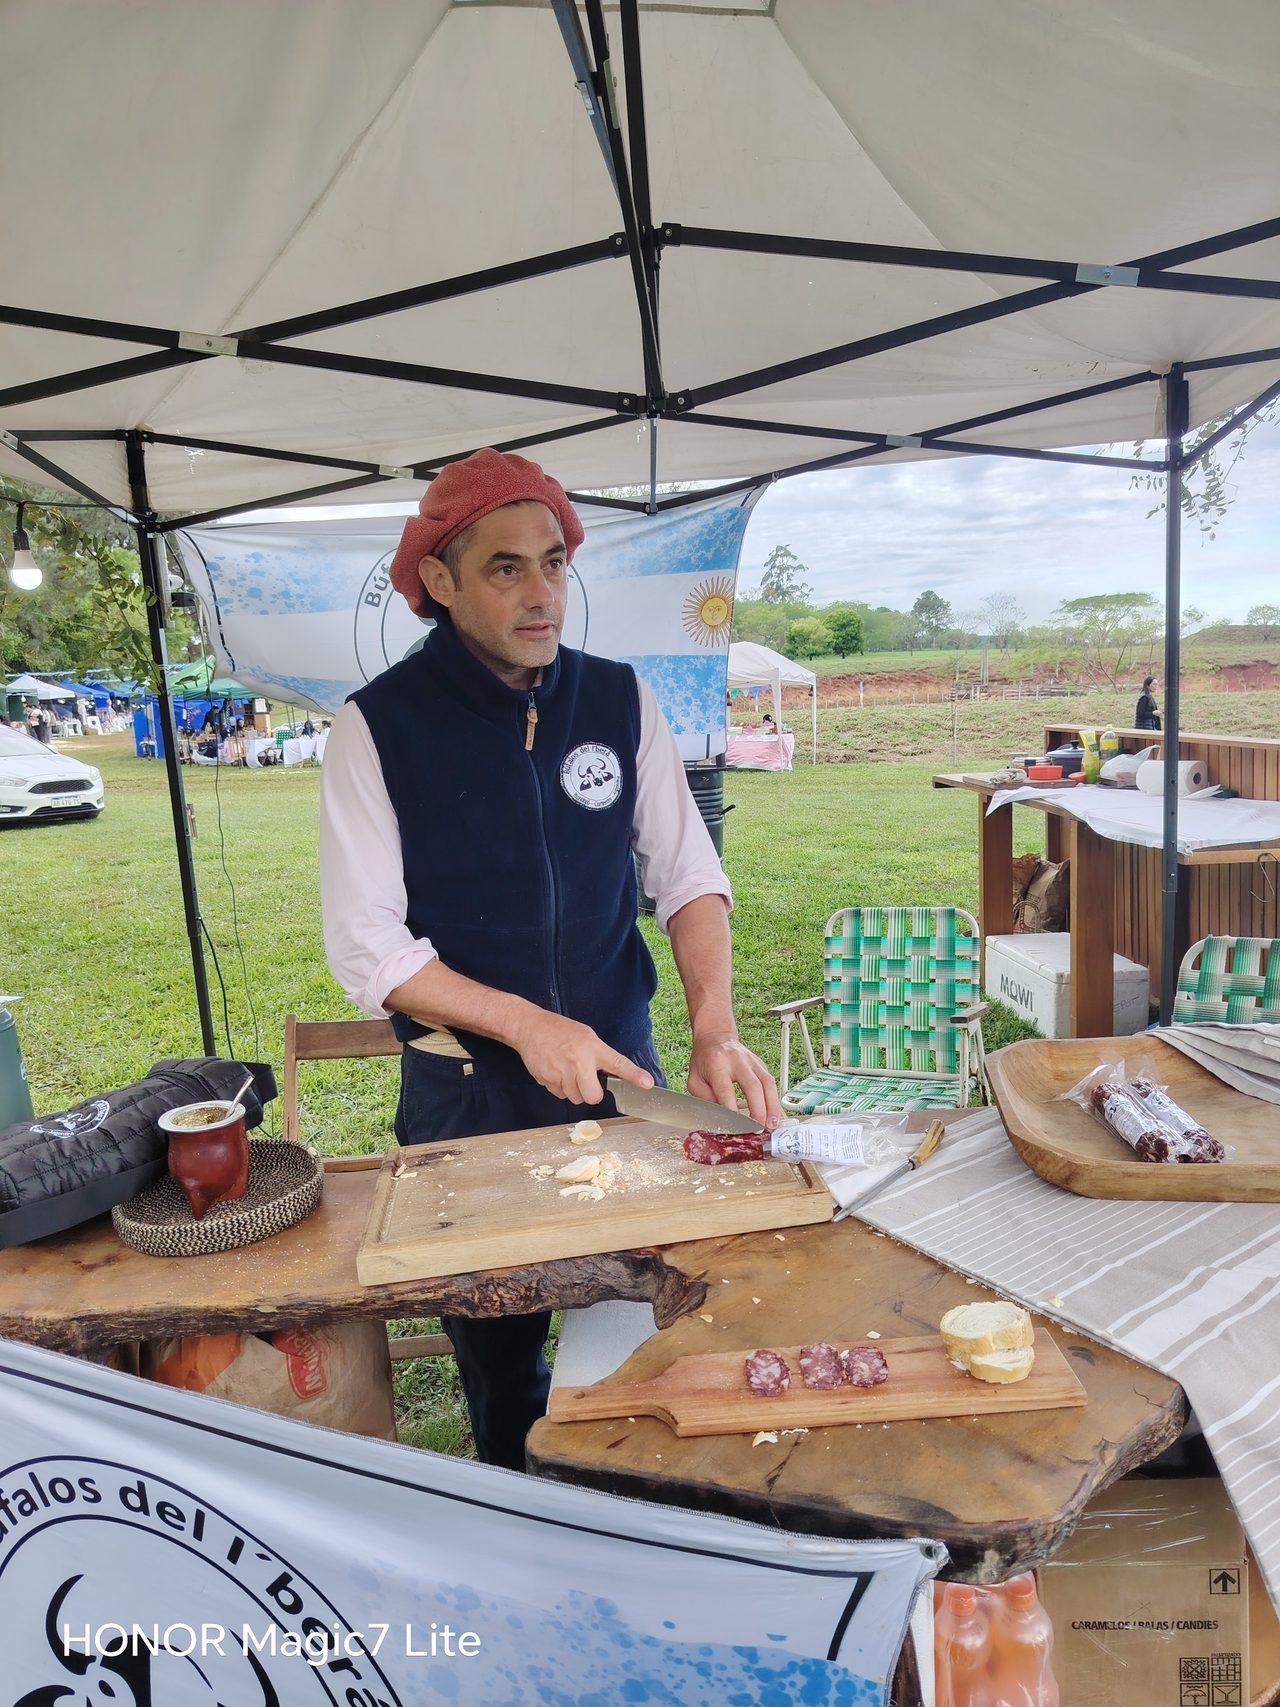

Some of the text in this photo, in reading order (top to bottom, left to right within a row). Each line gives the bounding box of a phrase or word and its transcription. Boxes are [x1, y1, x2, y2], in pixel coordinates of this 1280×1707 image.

[364, 563, 390, 606] Búf
[0, 1471, 102, 1543] falos
[119, 1479, 206, 1542] del
[1071, 1620, 1130, 1630] CARAMELOS
[1138, 1621, 1169, 1630] BALAS
[1176, 1620, 1219, 1630] CANDIES
